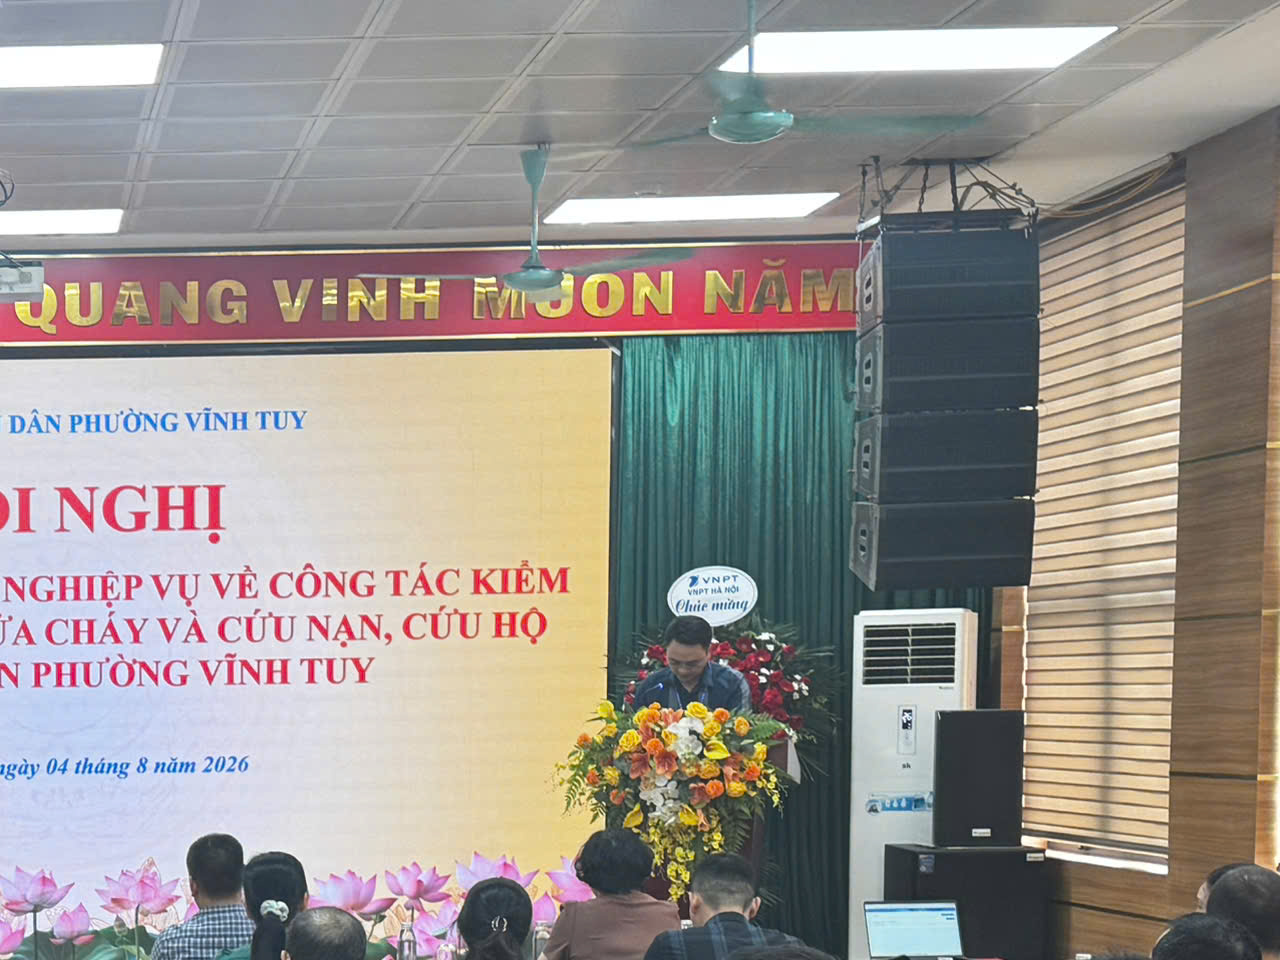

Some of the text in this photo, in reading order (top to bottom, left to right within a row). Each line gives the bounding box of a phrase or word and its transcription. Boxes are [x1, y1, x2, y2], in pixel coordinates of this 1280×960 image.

[14, 278, 247, 335] QUANG
[273, 277, 441, 323] VINH
[704, 258, 855, 314] NĂM
[9, 408, 62, 434] DÂN
[69, 409, 179, 434] PHƯỜNG
[185, 407, 249, 432] VĨNH
[255, 410, 307, 431] TUY
[54, 484, 227, 545] NGHỊ
[1, 570, 143, 608] NGHIỆP
[151, 574, 201, 607] VỤ
[210, 565, 259, 600] VỀ
[269, 563, 376, 600] CÔNG
[385, 562, 461, 597] TÁC
[470, 560, 571, 596] KIỂM
[688, 585, 739, 596] VNPT HÀ NỘI
[702, 575, 739, 584] VNPT
[45, 613, 150, 647] CHÁY
[155, 610, 208, 645] VÀ
[216, 608, 297, 644] CỨU
[306, 614, 394, 648] NẠN,
[401, 606, 482, 641] CỨU
[491, 609, 549, 645] HỘ
[31, 656, 191, 690] PHƯỜNG
[198, 653, 292, 687] VĨNH
[299, 657, 376, 685] TUY
[45, 757, 70, 775] 04
[73, 756, 131, 780] tháng
[136, 756, 149, 775] 8
[153, 757, 197, 775] năm
[201, 755, 250, 774] 2026
